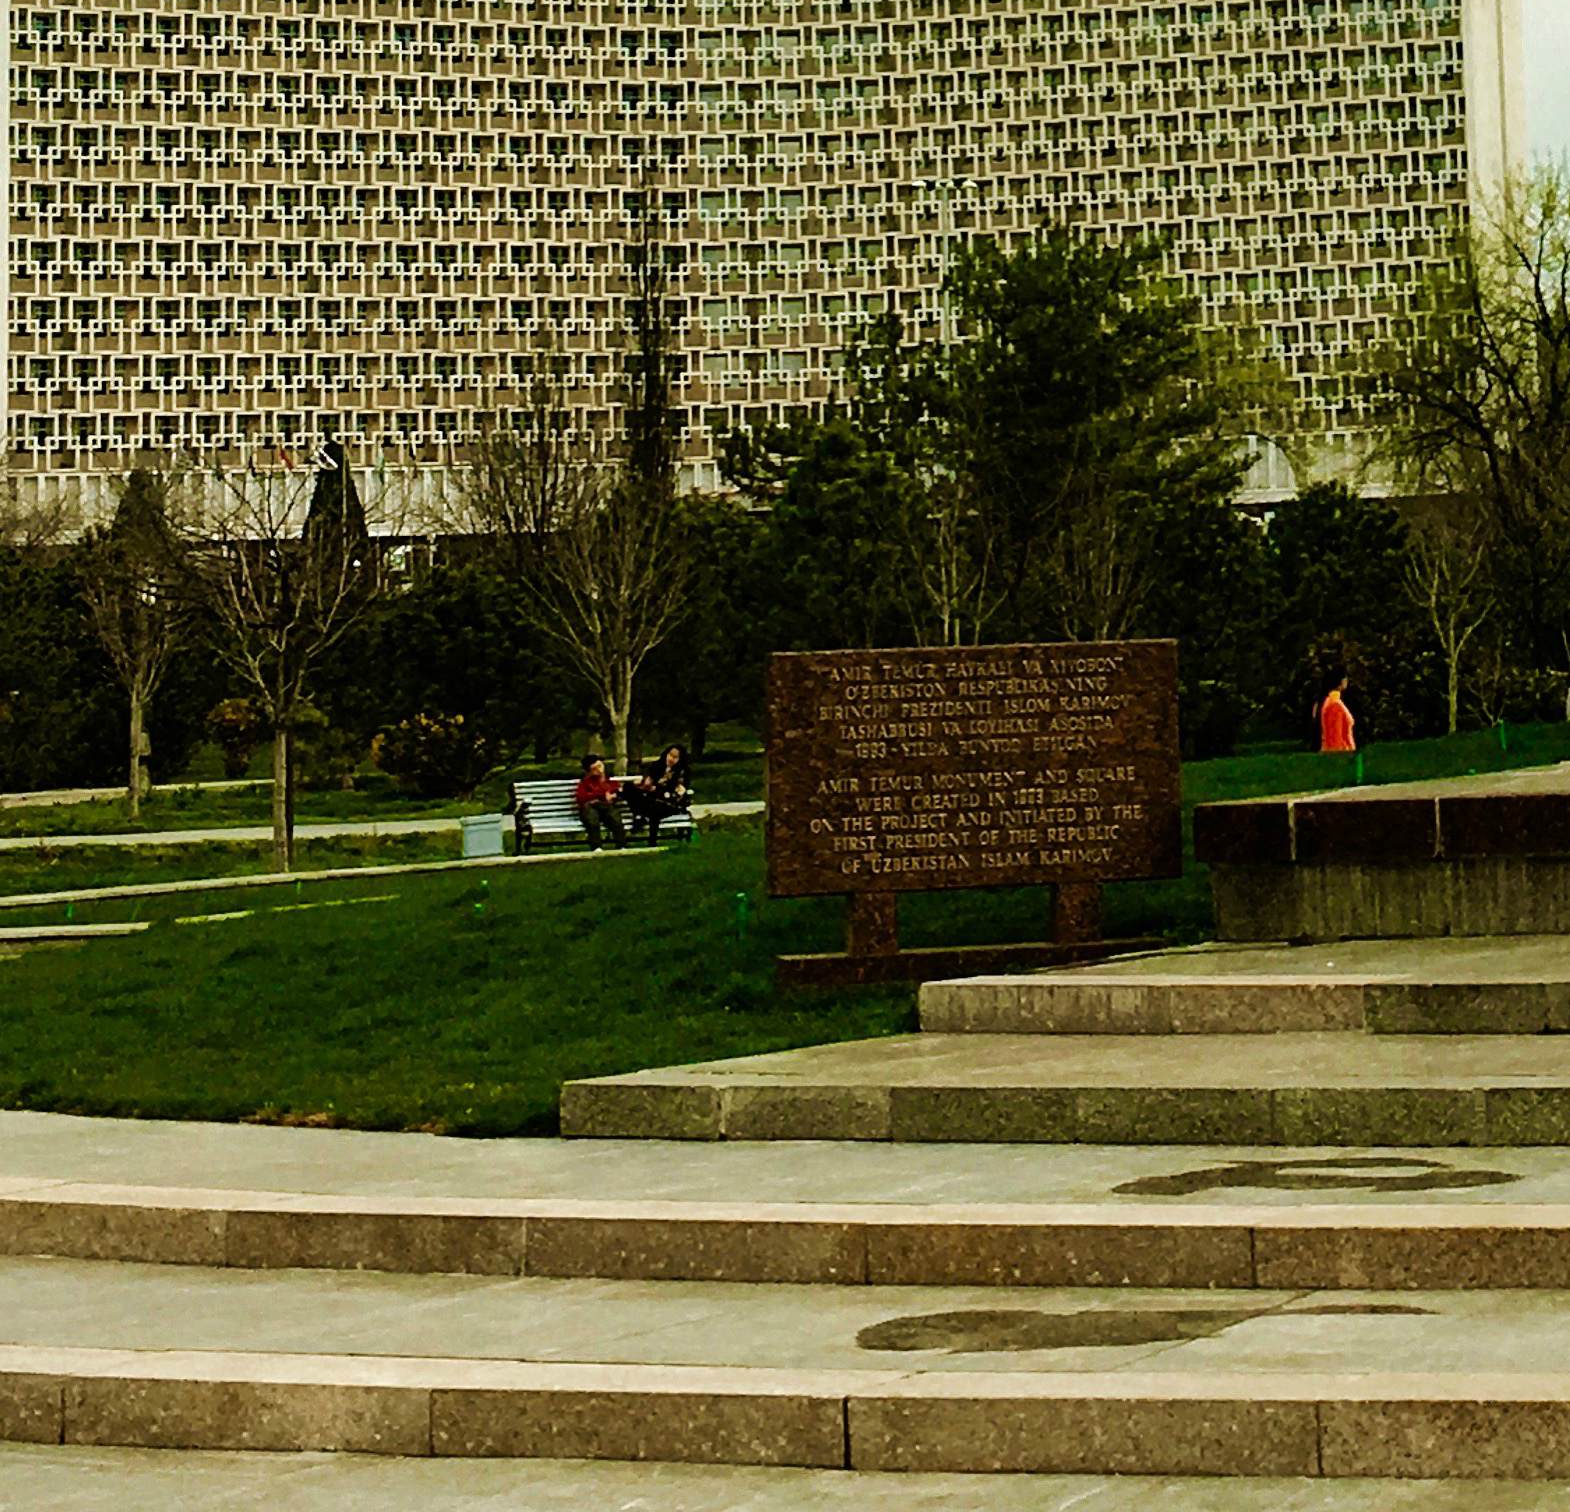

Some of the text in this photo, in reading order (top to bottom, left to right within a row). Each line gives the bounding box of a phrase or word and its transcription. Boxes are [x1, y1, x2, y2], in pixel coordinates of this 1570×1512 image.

[1022, 658, 1044, 676] VA
[900, 699, 993, 719] PREZIDENTI
[1003, 697, 1052, 715] ISLOM
[839, 721, 933, 740] TASHABBUSI
[817, 766, 1137, 795] AMIR TEMUR MONUMENT AND SQUARE
[855, 796, 904, 813] WERE
[911, 792, 981, 811] CREATED
[988, 791, 1006, 807] IN
[1050, 787, 1100, 805] BASED
[809, 803, 1145, 835] ON THE PROJECT AND INITIATED BY THE
[832, 823, 1121, 852] FIRST PRESIDENT OF THE REPUBLIC
[840, 847, 1114, 875] OF UZBEKISTAN ISLAM KARIMOV
